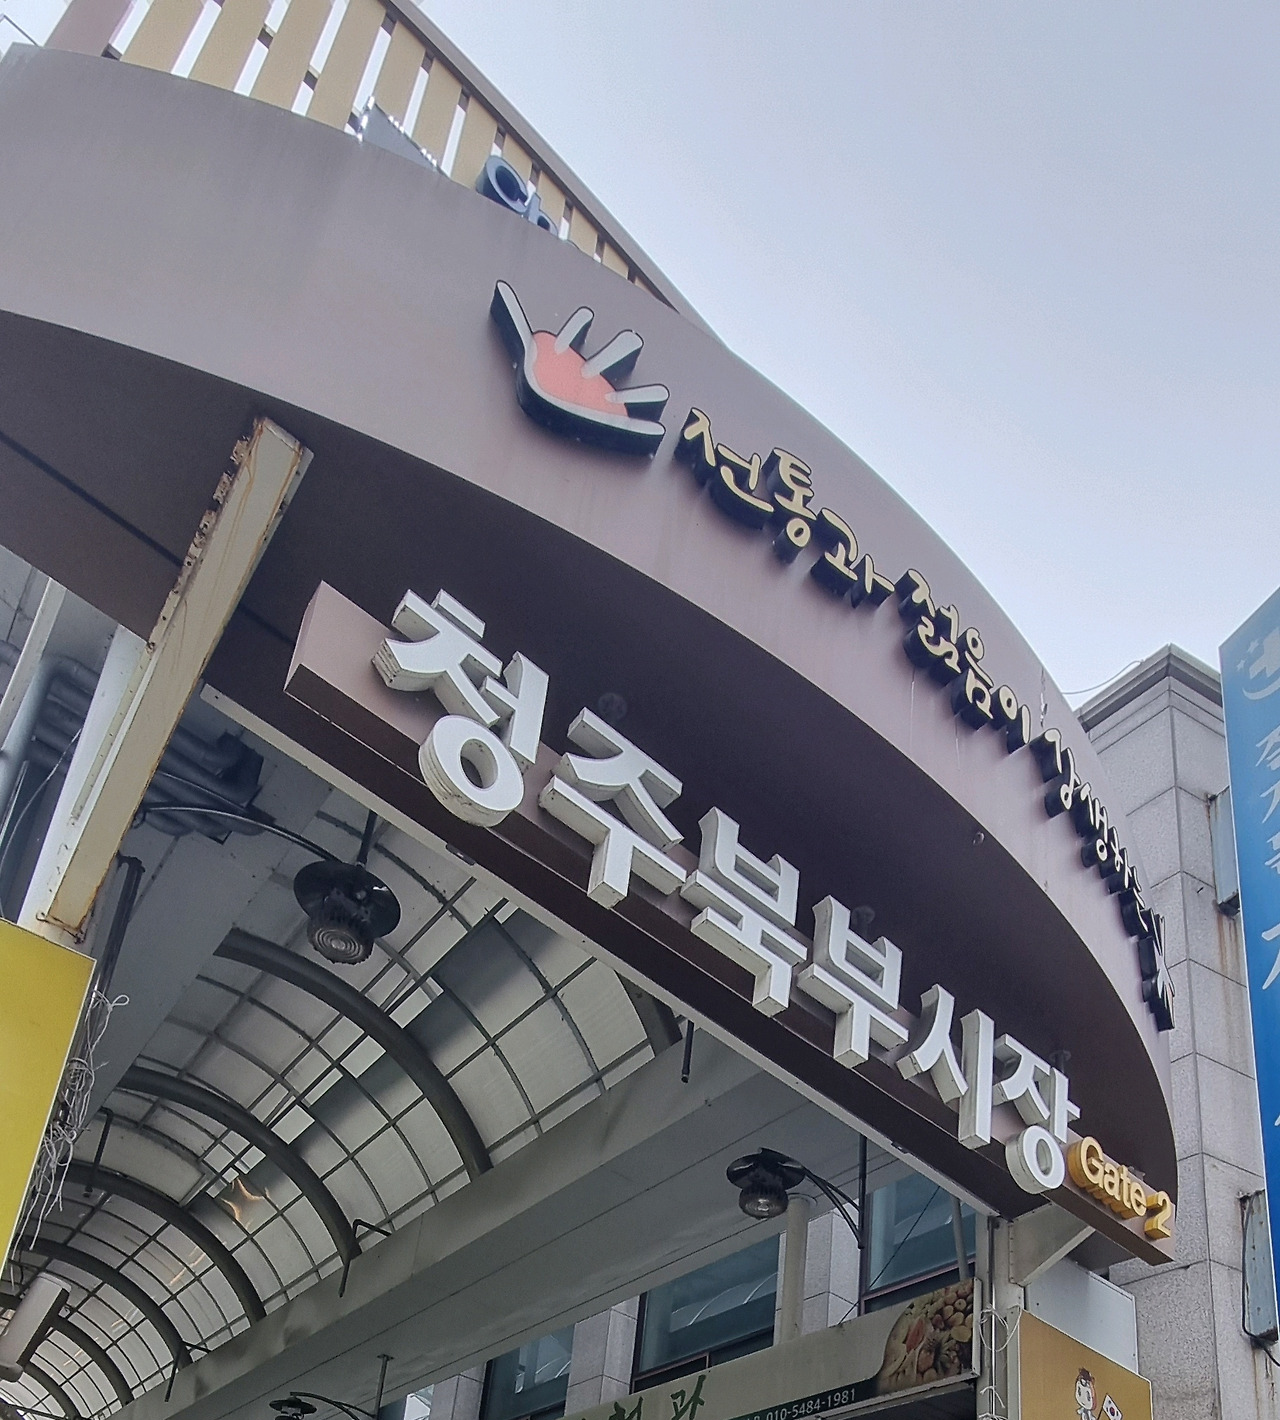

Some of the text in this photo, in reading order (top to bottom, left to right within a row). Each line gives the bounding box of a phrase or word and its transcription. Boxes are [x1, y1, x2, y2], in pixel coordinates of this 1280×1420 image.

[680, 407, 896, 598] 전통과
[900, 568, 1032, 745] 젊음이
[380, 589, 1080, 1194] 청주북부시장
[1076, 1136, 1171, 1238] Gate 2
